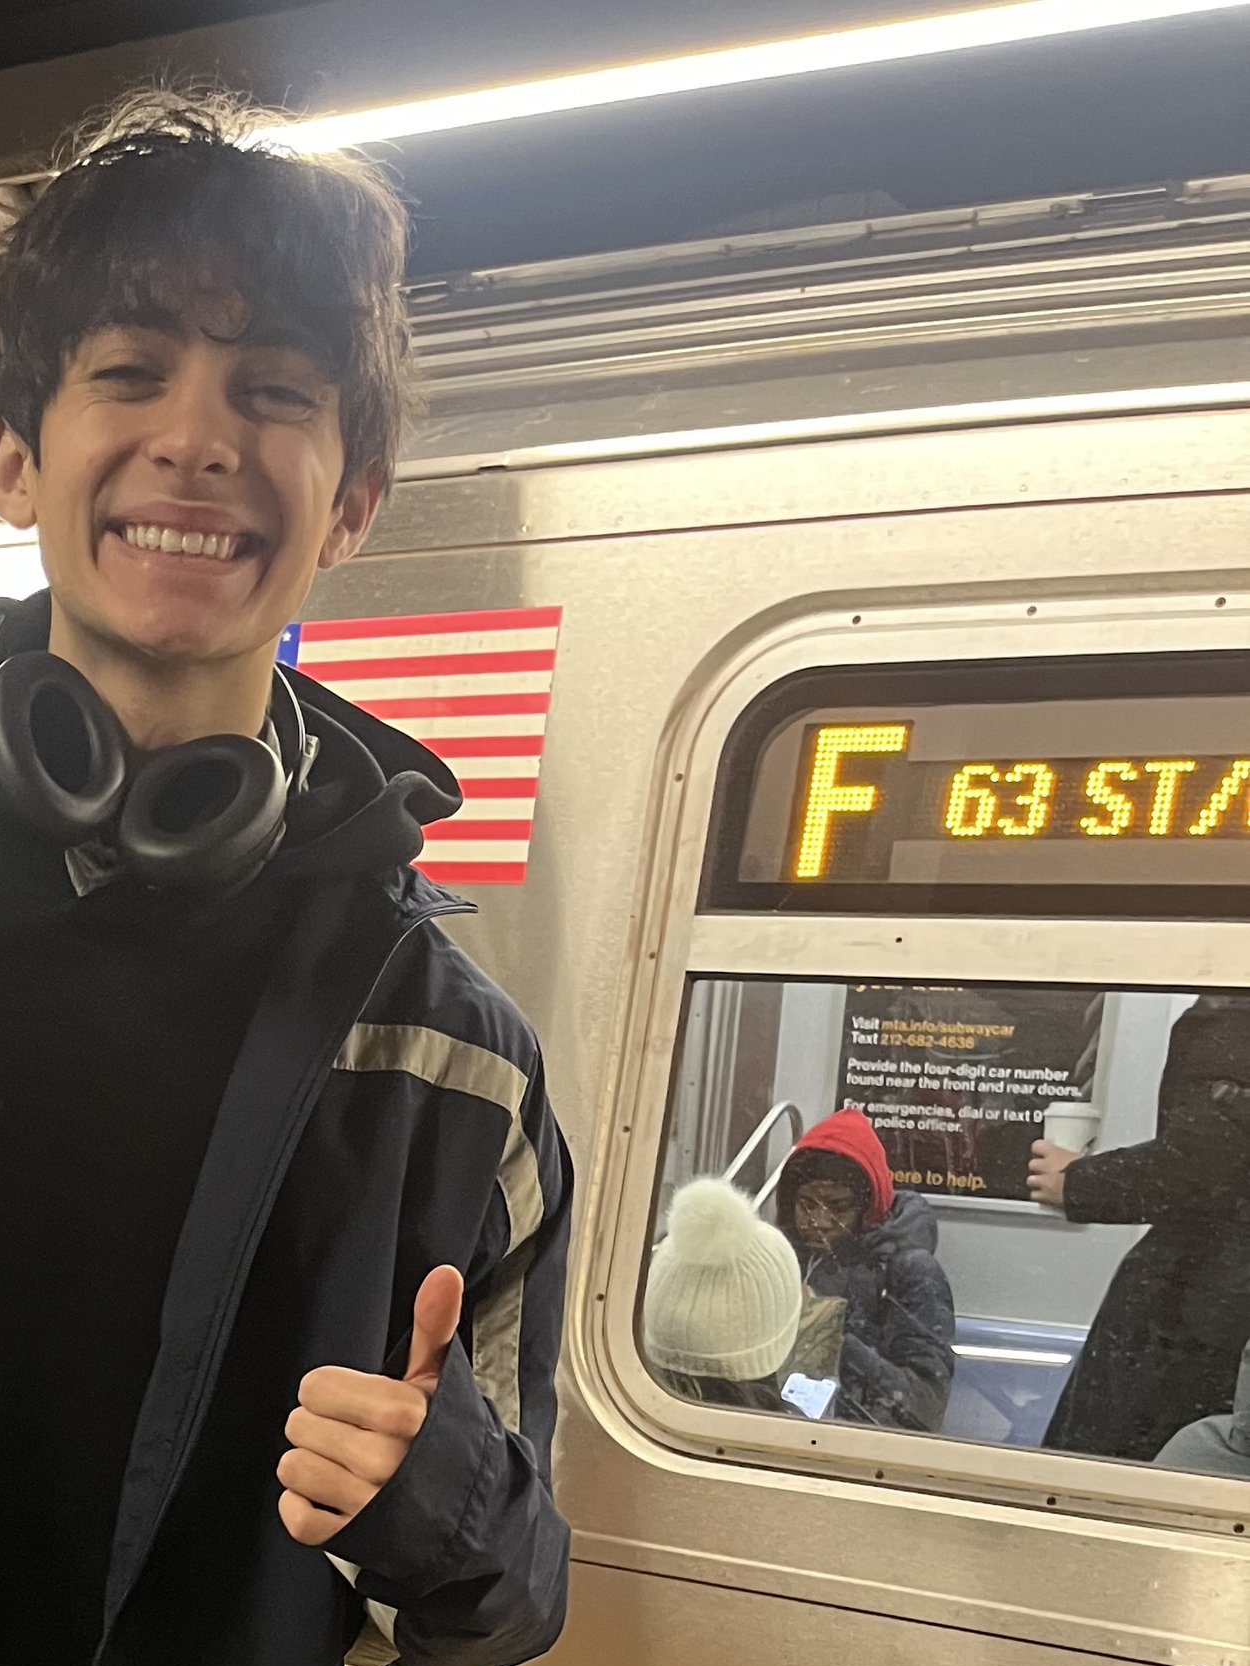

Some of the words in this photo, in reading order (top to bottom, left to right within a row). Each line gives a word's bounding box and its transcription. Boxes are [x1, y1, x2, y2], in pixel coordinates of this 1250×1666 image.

[795, 725, 908, 879] F
[944, 763, 1054, 838] 63
[1079, 761, 1250, 837] ST/
[852, 1016, 880, 1031] Visit
[881, 1019, 1015, 1036] mta.info/subwaycar
[851, 1031, 878, 1045] Text
[848, 1058, 897, 1073] Provide
[900, 1060, 921, 1075] the
[924, 1062, 986, 1079] four-digit
[988, 1068, 1011, 1078] car
[1013, 1068, 1069, 1082] number
[847, 1073, 883, 1087] found
[886, 1077, 916, 1089] near
[918, 1076, 940, 1091] the
[943, 1078, 975, 1092] front
[977, 1081, 1004, 1094] and
[1006, 1083, 1035, 1095] rear
[1037, 1083, 1082, 1098] doors.
[867, 1102, 956, 1119] emergencies,
[958, 1106, 983, 1119] dial
[985, 1109, 1000, 1120] or
[1003, 1109, 1030, 1122] text
[1033, 1110, 1045, 1123] 9
[874, 1115, 915, 1130] police
[917, 1118, 963, 1133] officer.
[926, 1170, 943, 1186] to
[947, 1172, 987, 1190] help.
